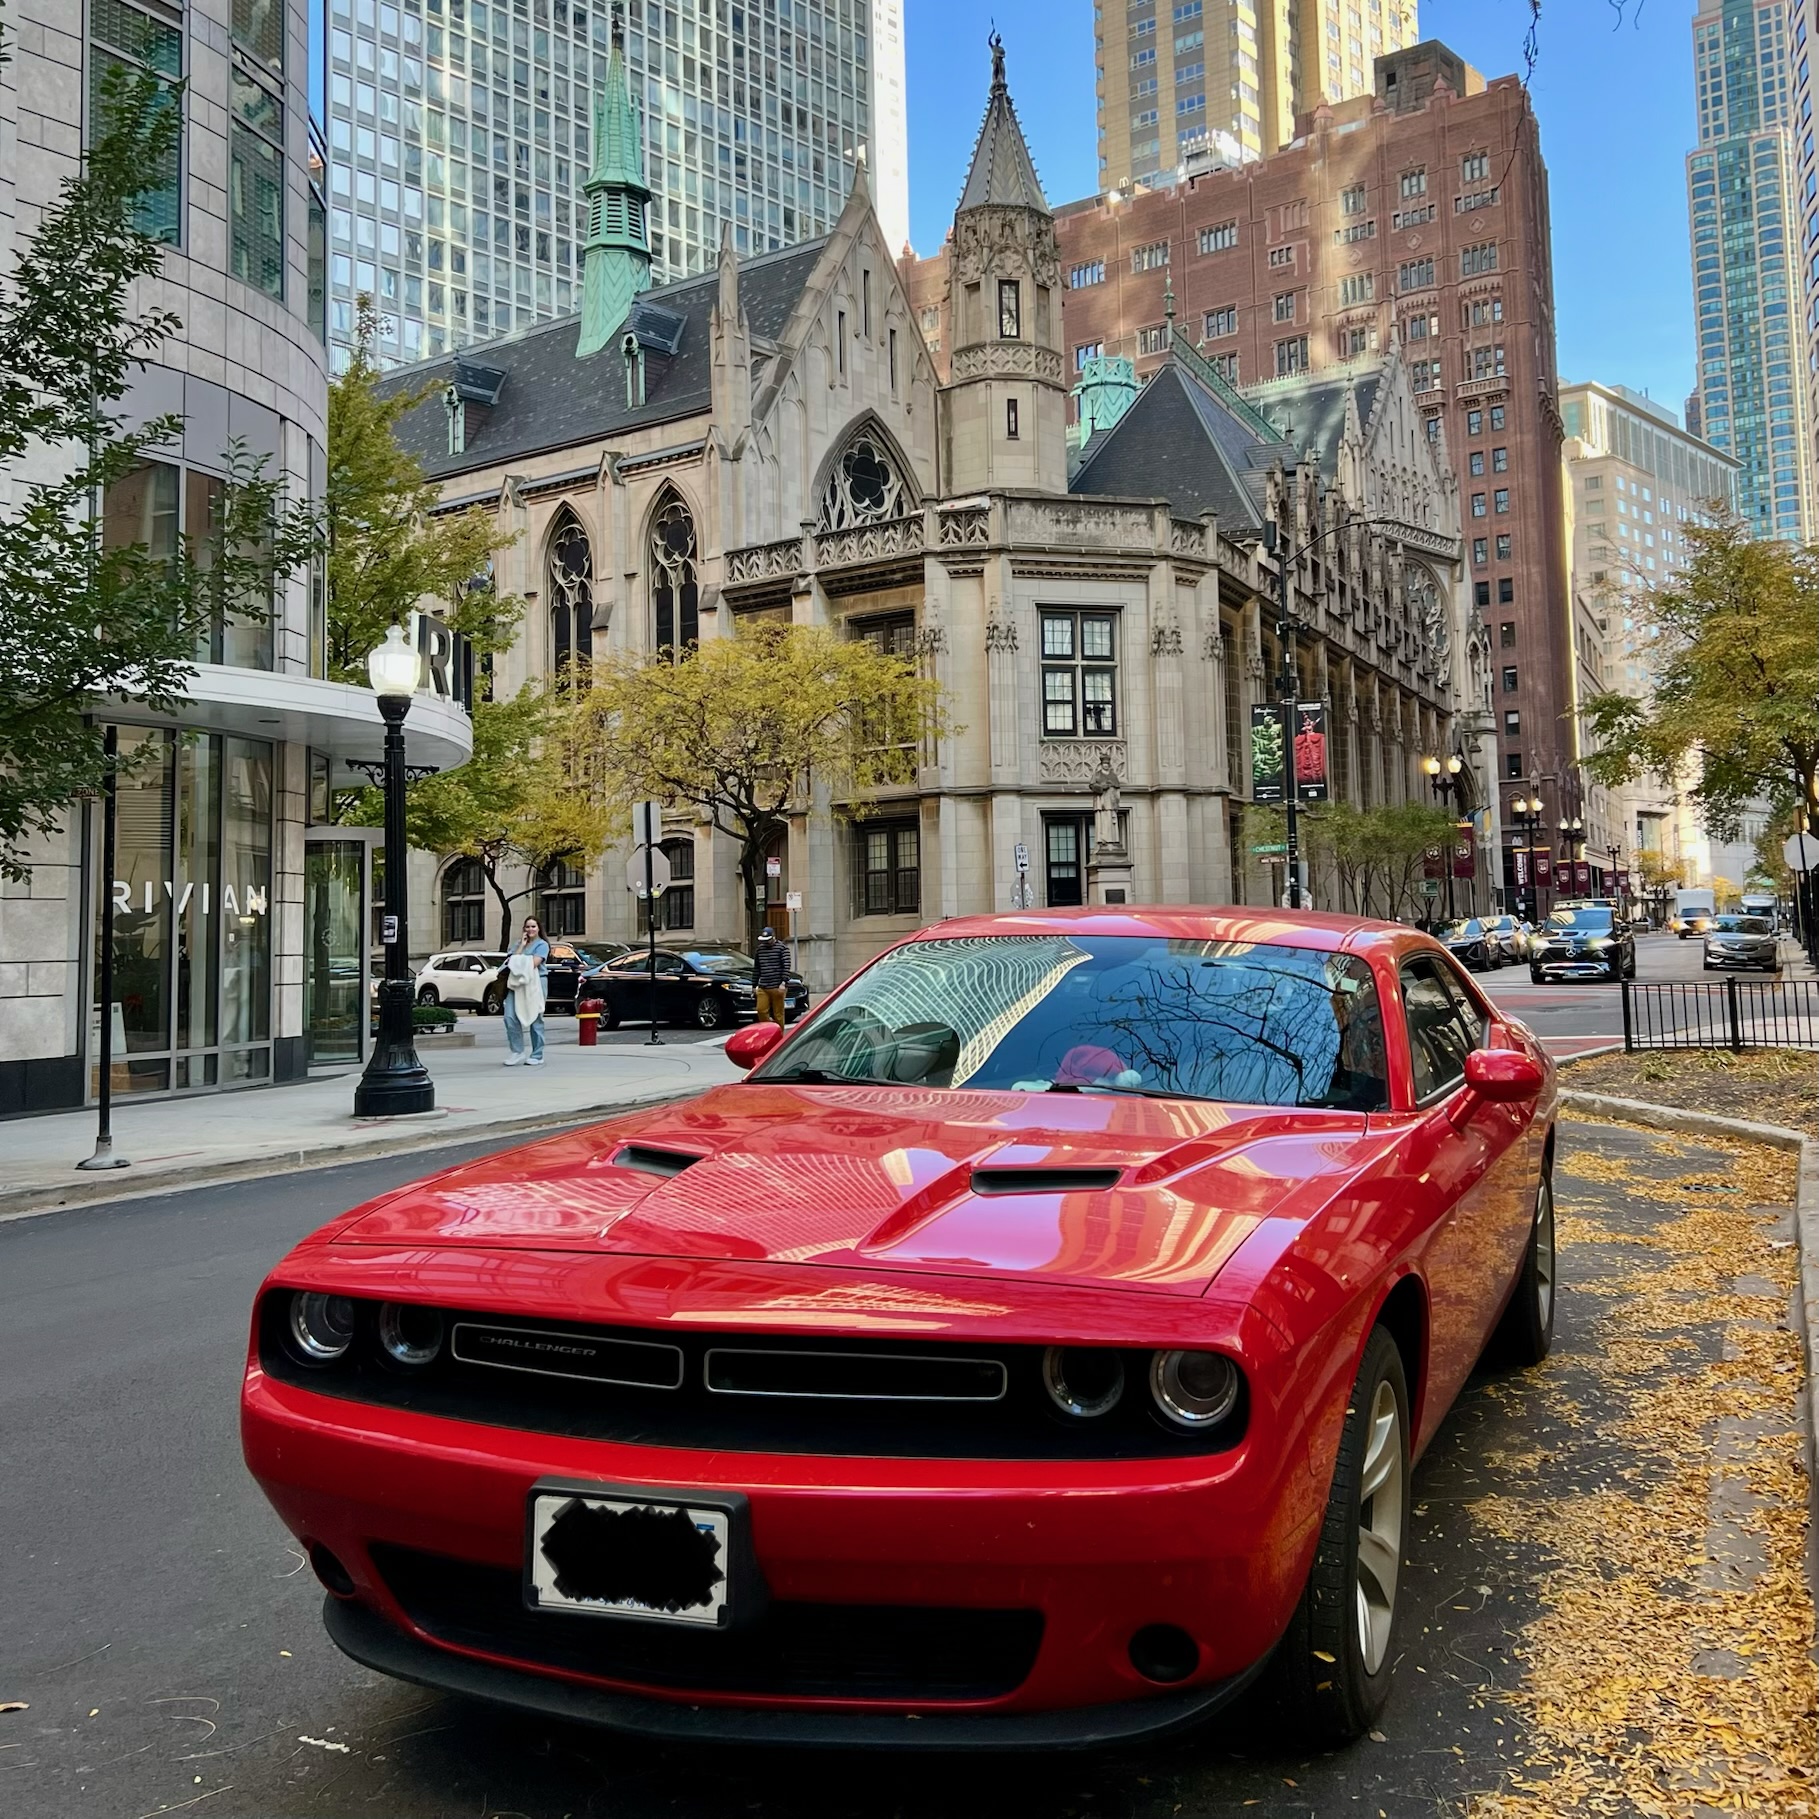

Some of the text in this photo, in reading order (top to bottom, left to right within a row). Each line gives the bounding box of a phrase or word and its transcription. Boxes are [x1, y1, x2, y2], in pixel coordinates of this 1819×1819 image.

[1516, 853, 1525, 885] WELCOME
[112, 880, 266, 916] RIVIAN
[479, 1336, 597, 1357] CHALLENGER
